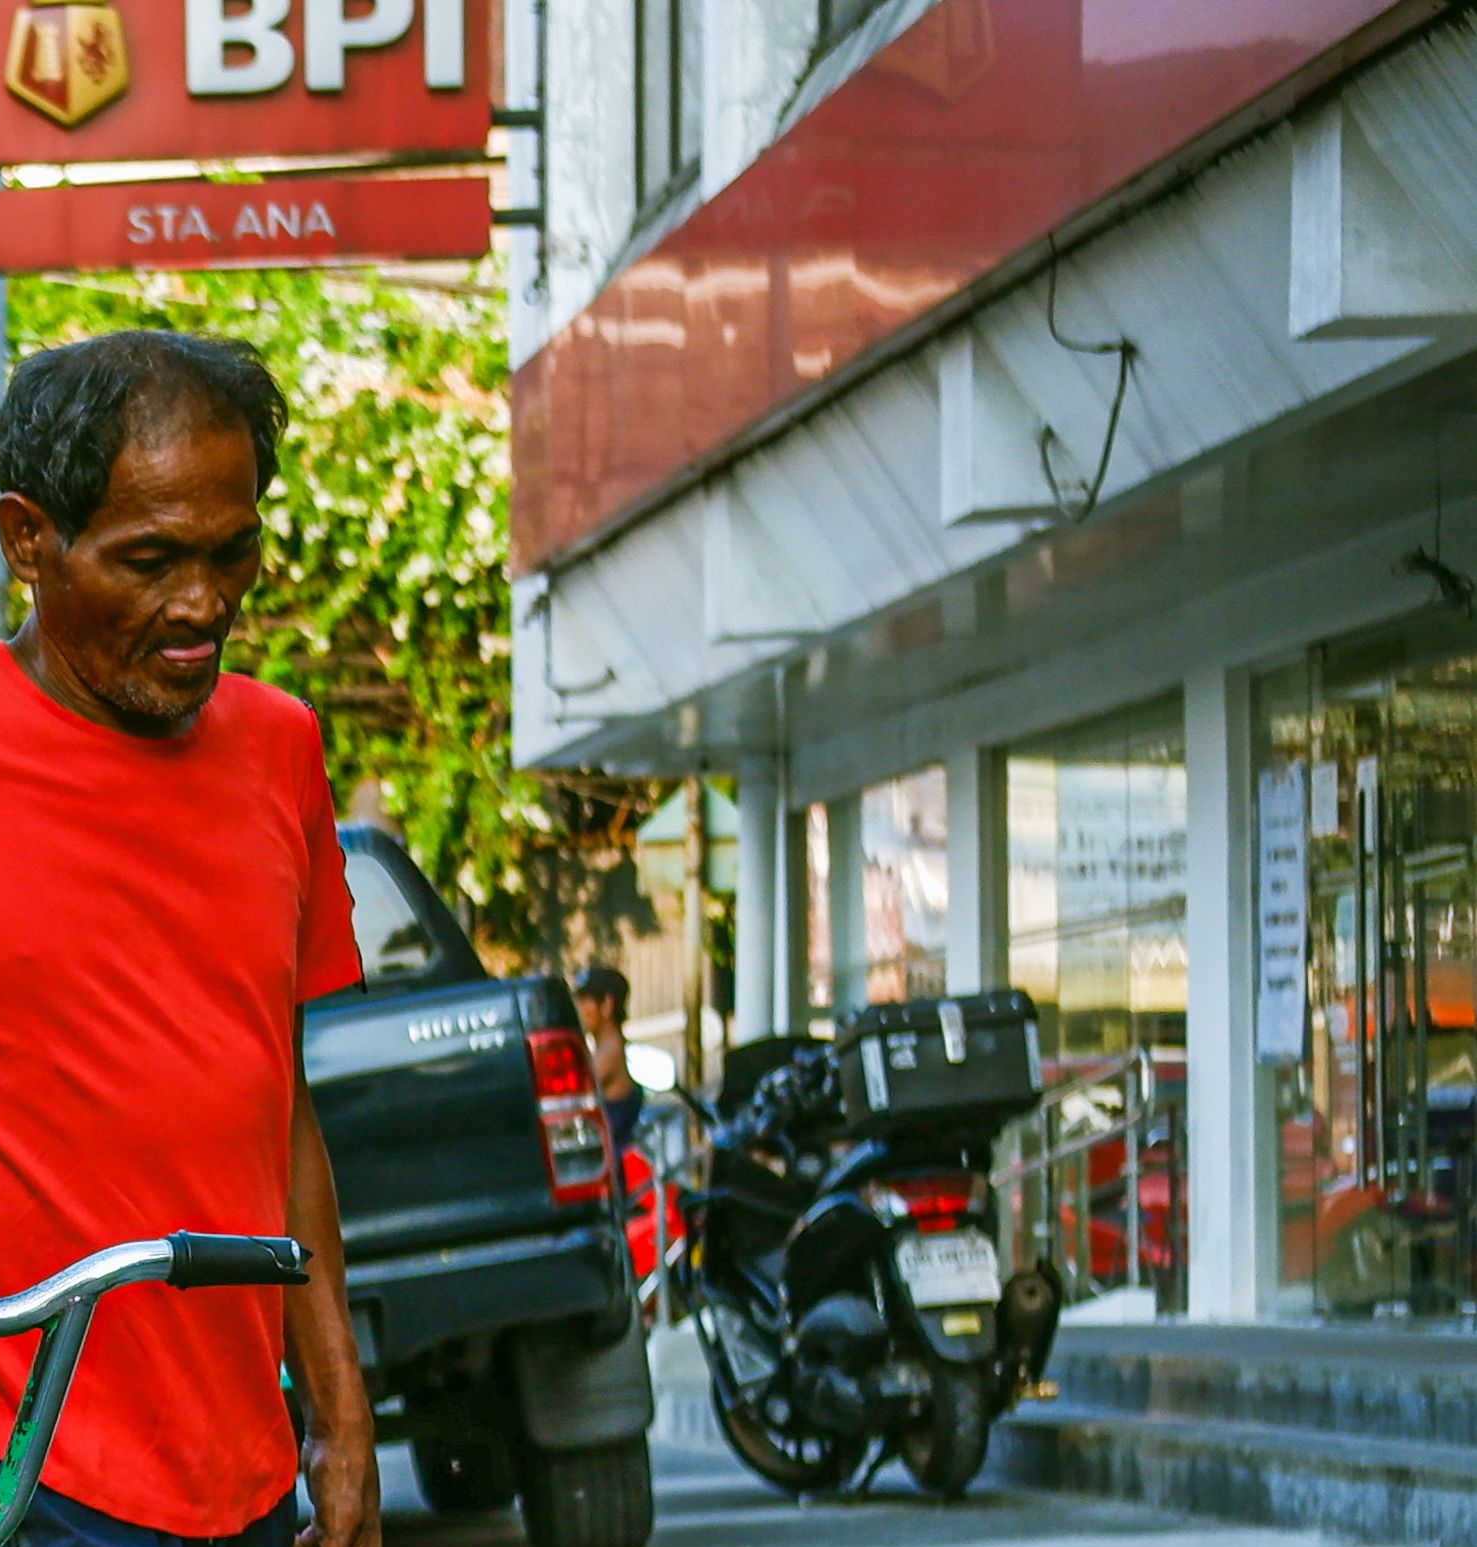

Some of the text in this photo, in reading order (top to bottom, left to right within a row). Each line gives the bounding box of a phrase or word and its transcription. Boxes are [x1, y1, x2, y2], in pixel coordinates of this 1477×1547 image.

[186, 0, 465, 95] BPI
[127, 202, 337, 245] STA. ANA
